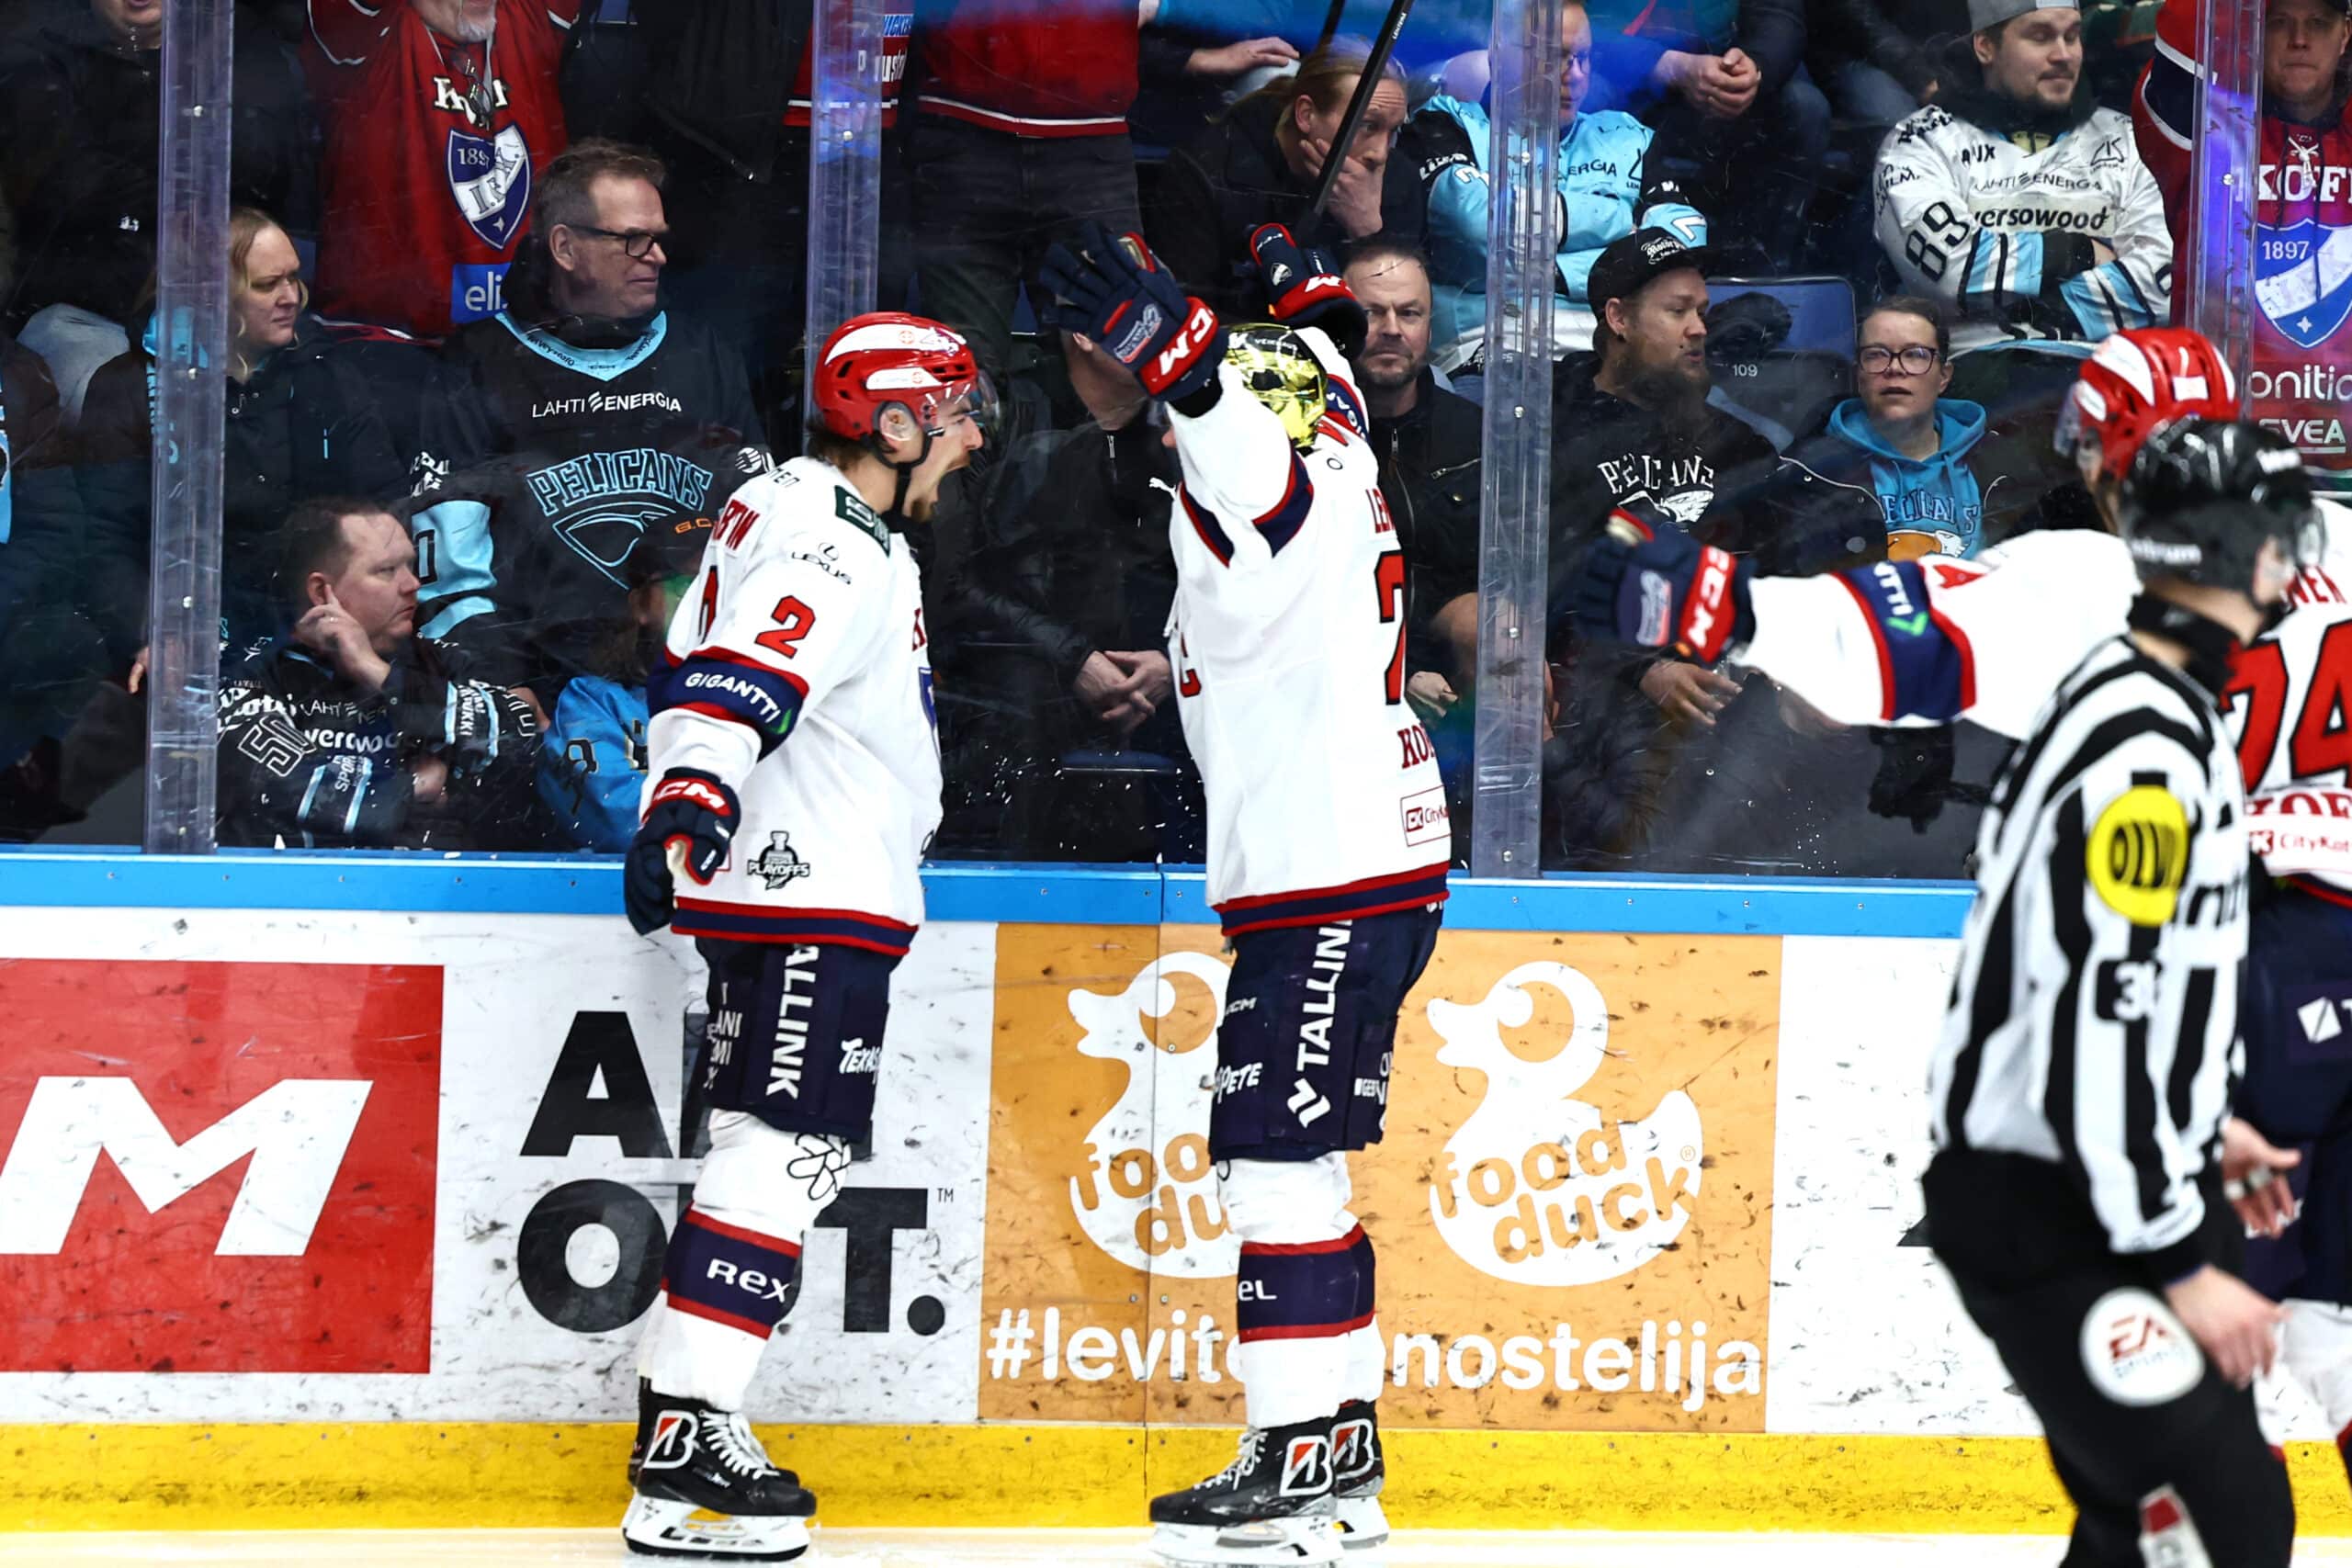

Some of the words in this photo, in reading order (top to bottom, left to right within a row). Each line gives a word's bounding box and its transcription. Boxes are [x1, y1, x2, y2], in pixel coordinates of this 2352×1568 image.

[1567, 159, 1617, 177] ERGIA
[2033, 172, 2103, 192] ENERGA
[1906, 201, 1970, 281] 89
[2262, 240, 2310, 260] 1897
[465, 271, 508, 312] eli
[1733, 364, 1758, 378] 109
[532, 398, 585, 418] LAHTI
[605, 390, 682, 412] ENERGIA
[526, 447, 714, 516] PELICANS
[791, 551, 852, 585] LEXUS
[754, 594, 816, 660] 2
[684, 671, 781, 723] GIGANTTI
[748, 860, 809, 877] PLAYOFFS
[766, 944, 820, 1100] ALLINK
[0, 1075, 374, 1257] M
[1070, 1133, 1213, 1212] foo
[1430, 1107, 1628, 1219] food
[1493, 1156, 1697, 1264] duck
